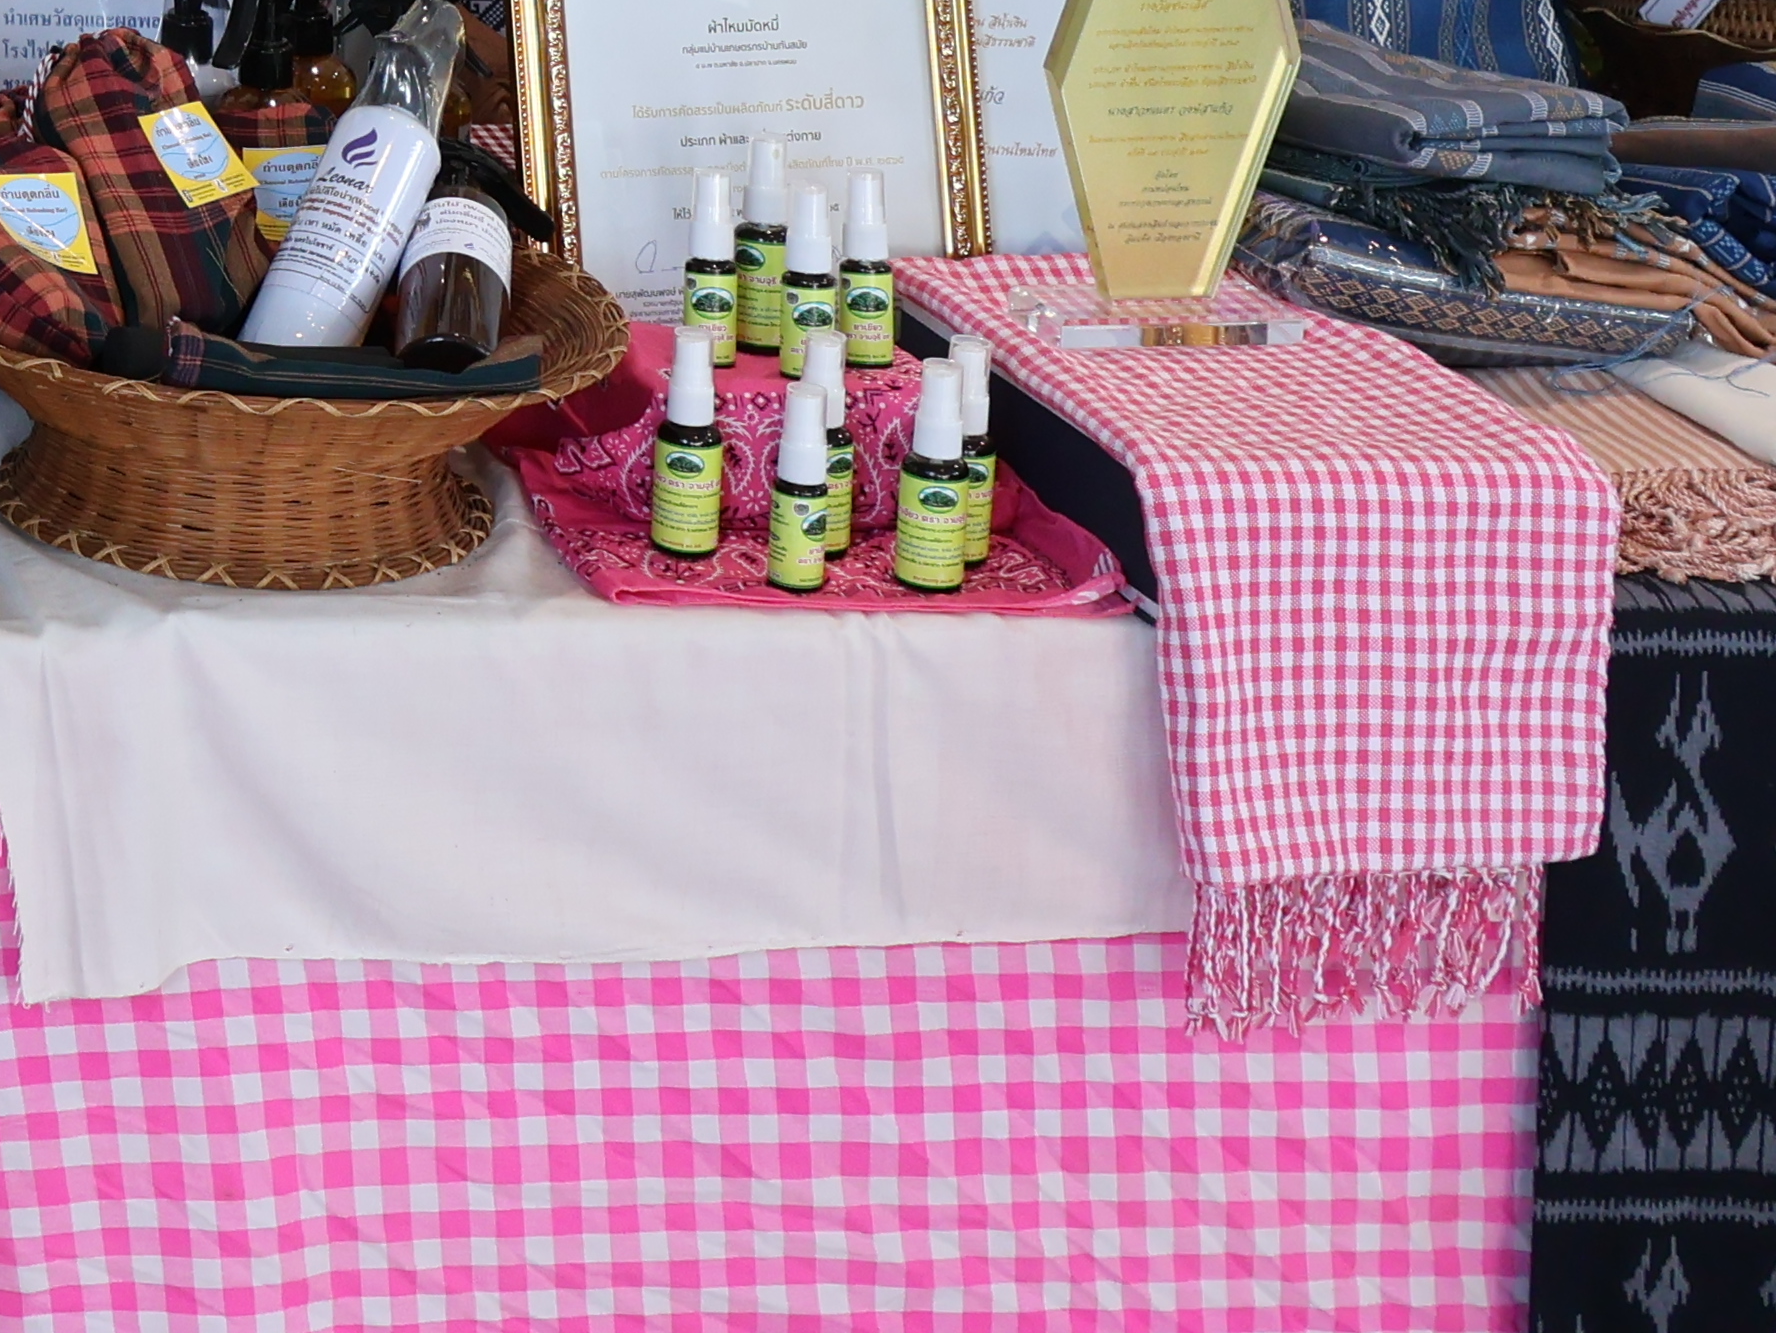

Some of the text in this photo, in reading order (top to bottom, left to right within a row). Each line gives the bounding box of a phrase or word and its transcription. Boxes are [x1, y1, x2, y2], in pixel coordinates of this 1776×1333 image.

[3, 9, 160, 33] นำเศษวัสดุและผลพล
[708, 14, 779, 33] ผ้าไหมมัดหมี่
[632, 88, 864, 118] ได้รับการคัดสรรเป็นผลิตภัณฑ์ ระดับสี่ดาว
[680, 135, 716, 148] ประเภท
[0, 183, 60, 201] ถ่านดูดกลิ่น
